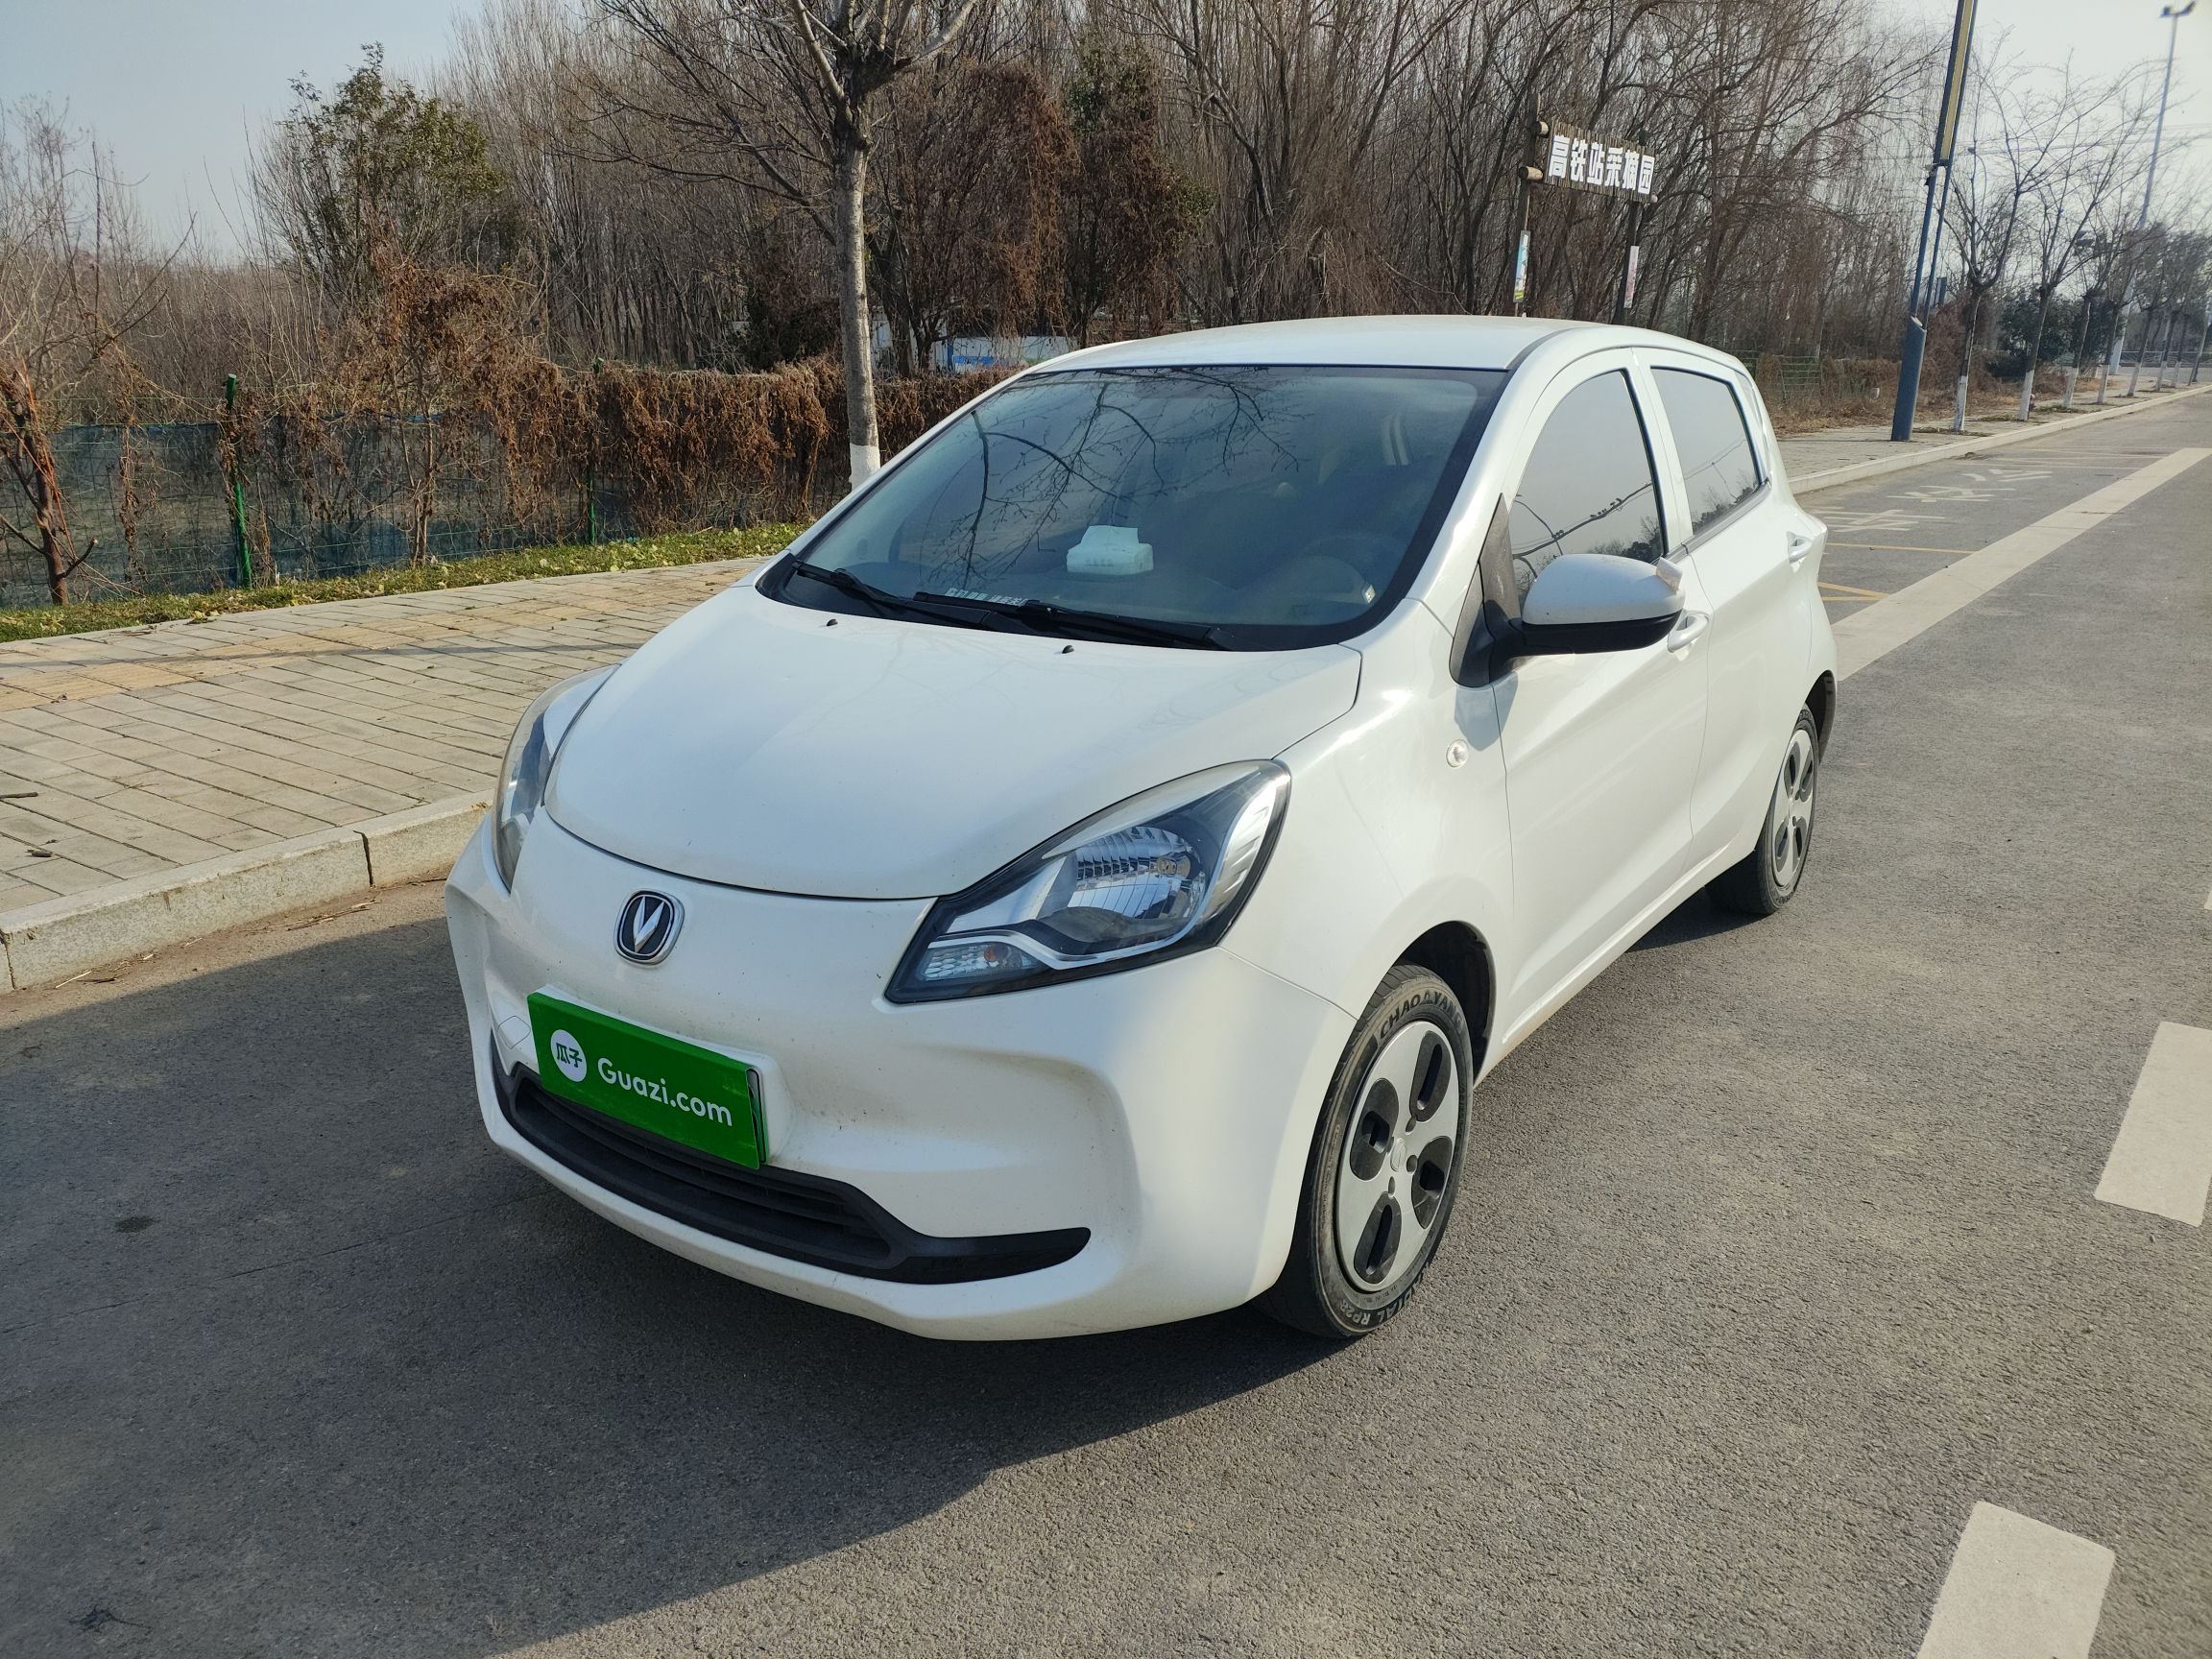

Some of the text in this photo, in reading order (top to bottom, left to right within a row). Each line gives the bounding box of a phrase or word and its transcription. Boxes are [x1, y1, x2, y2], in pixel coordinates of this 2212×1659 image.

[1549, 134, 1655, 195] 高铁站采摘园
[556, 1042, 583, 1069] 瓜子
[597, 1057, 733, 1127] Guazi.com
